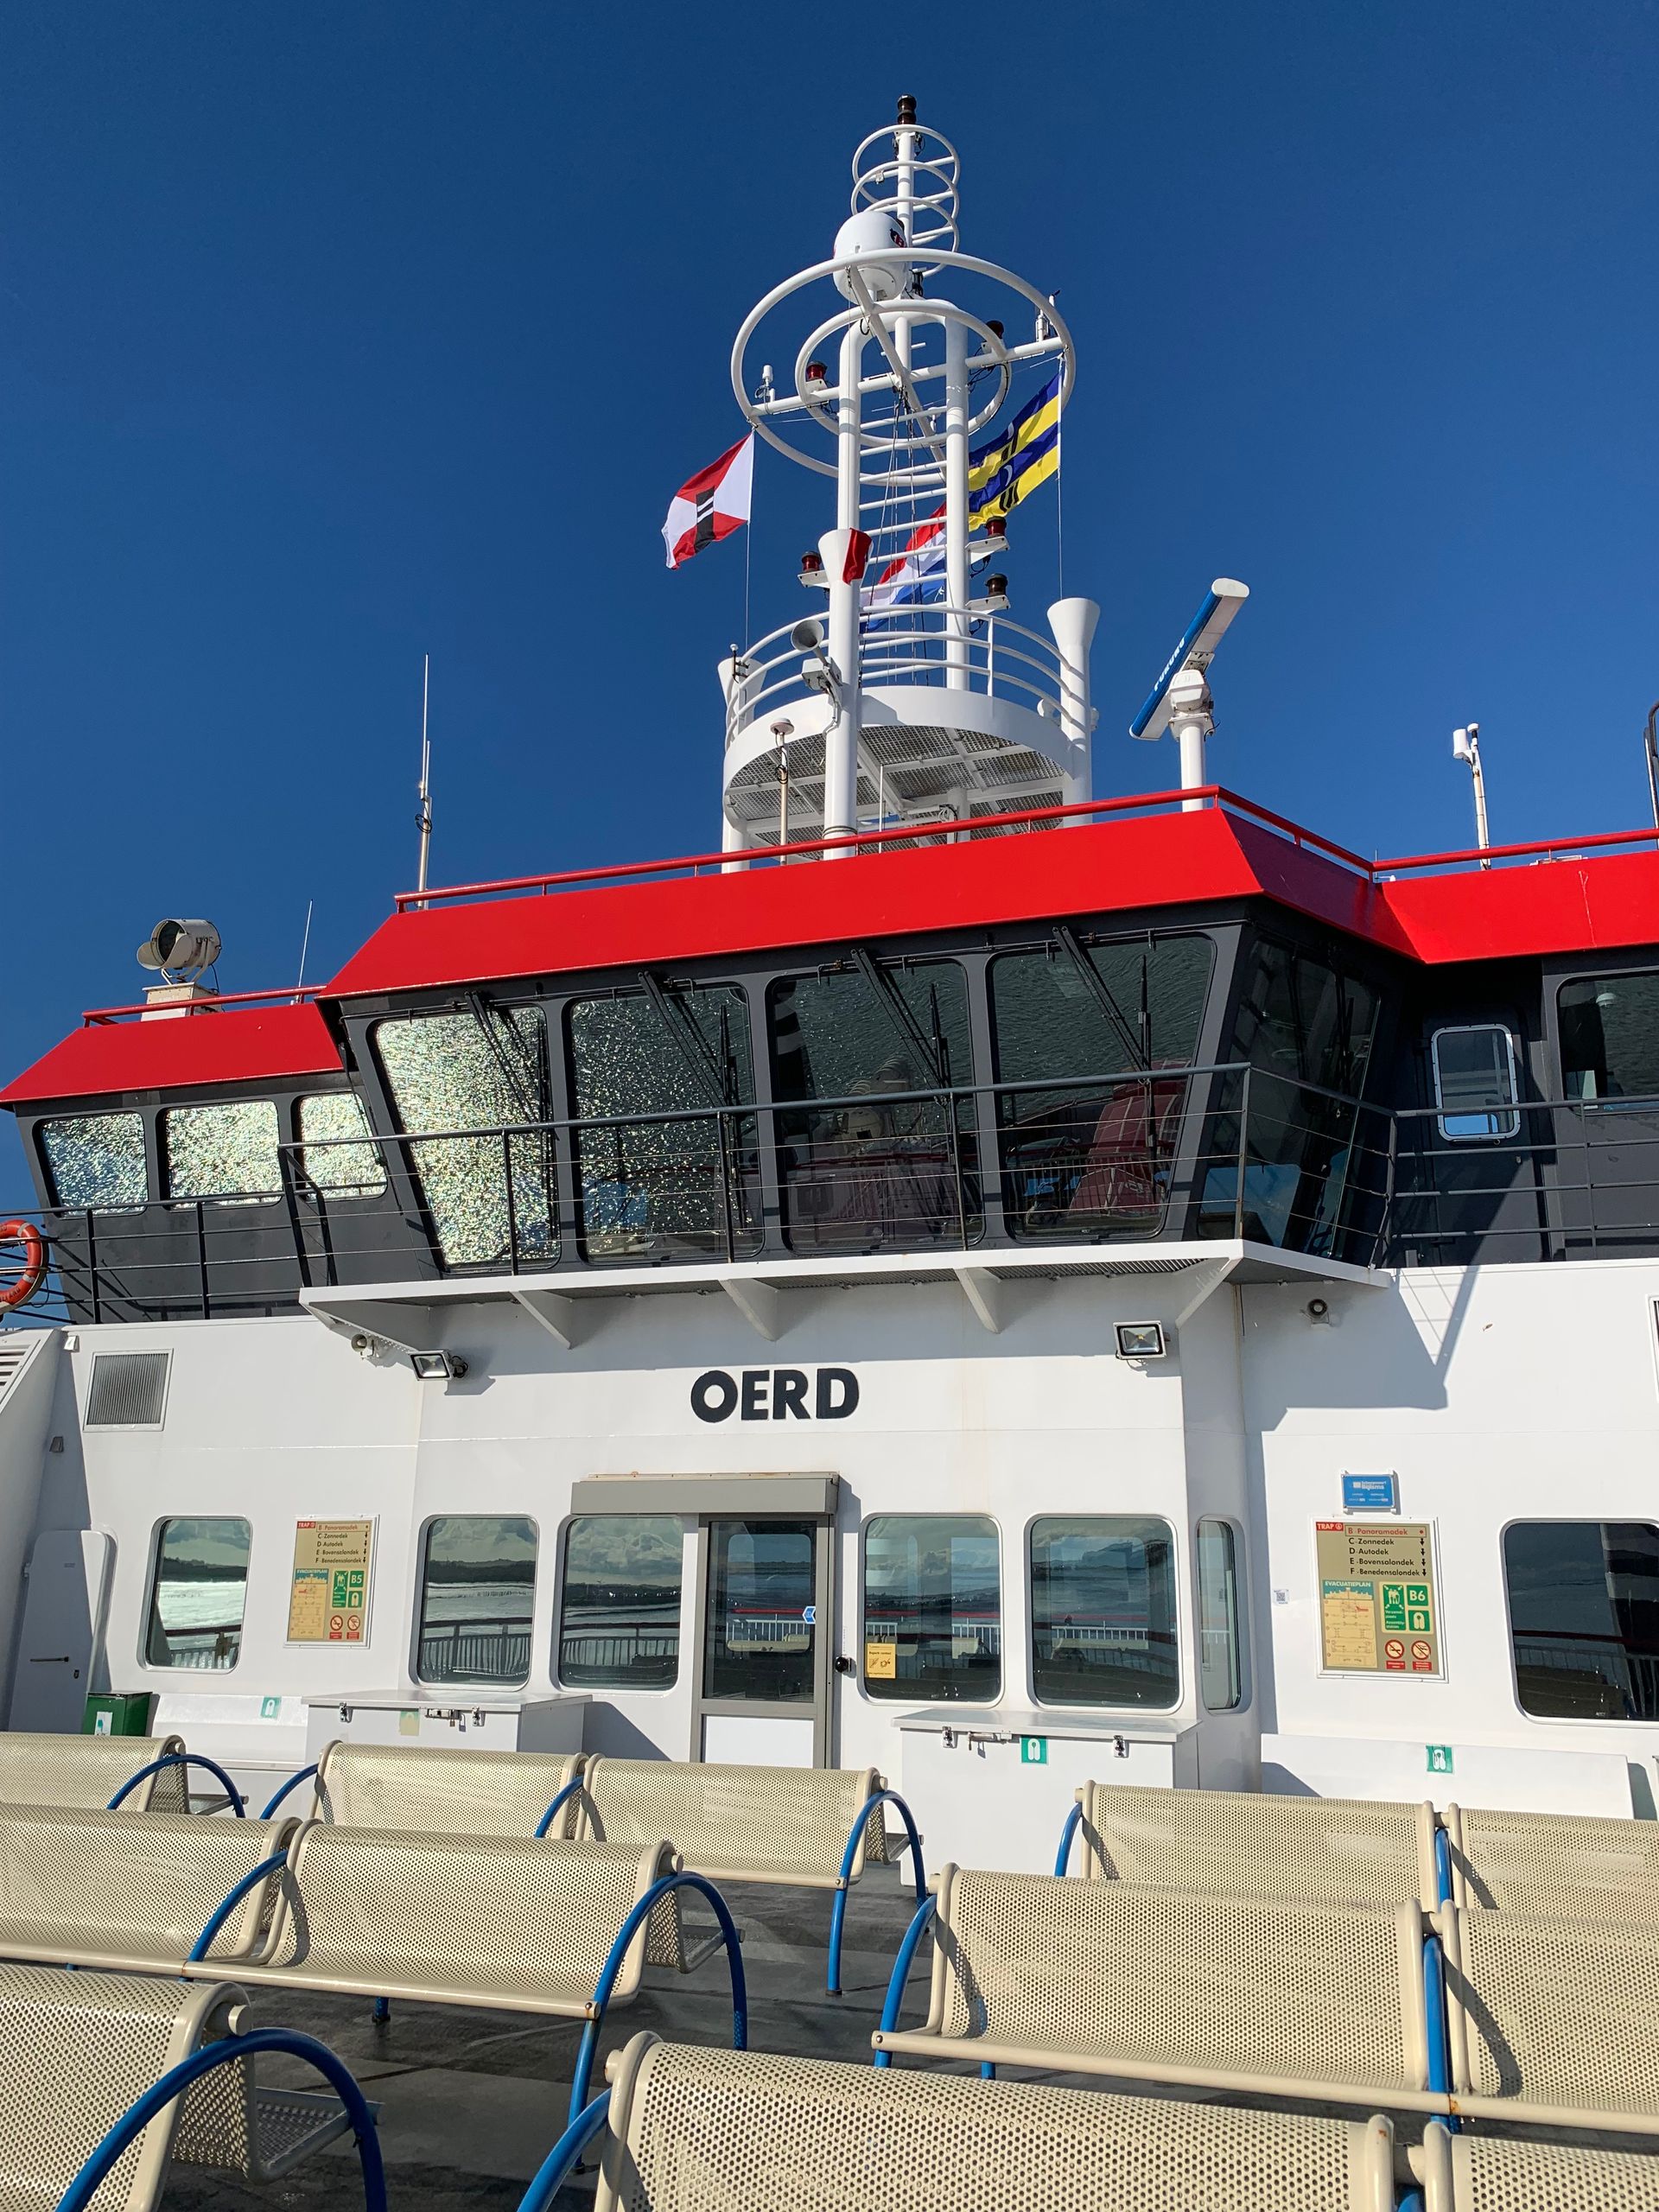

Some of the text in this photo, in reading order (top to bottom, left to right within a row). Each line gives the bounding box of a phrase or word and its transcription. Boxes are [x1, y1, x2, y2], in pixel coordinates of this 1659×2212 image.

[1154, 637, 1185, 691] FURUNO
[690, 1368, 860, 1423] OERD
[351, 1574, 363, 1584] B5
[1409, 1590, 1426, 1601] B6
